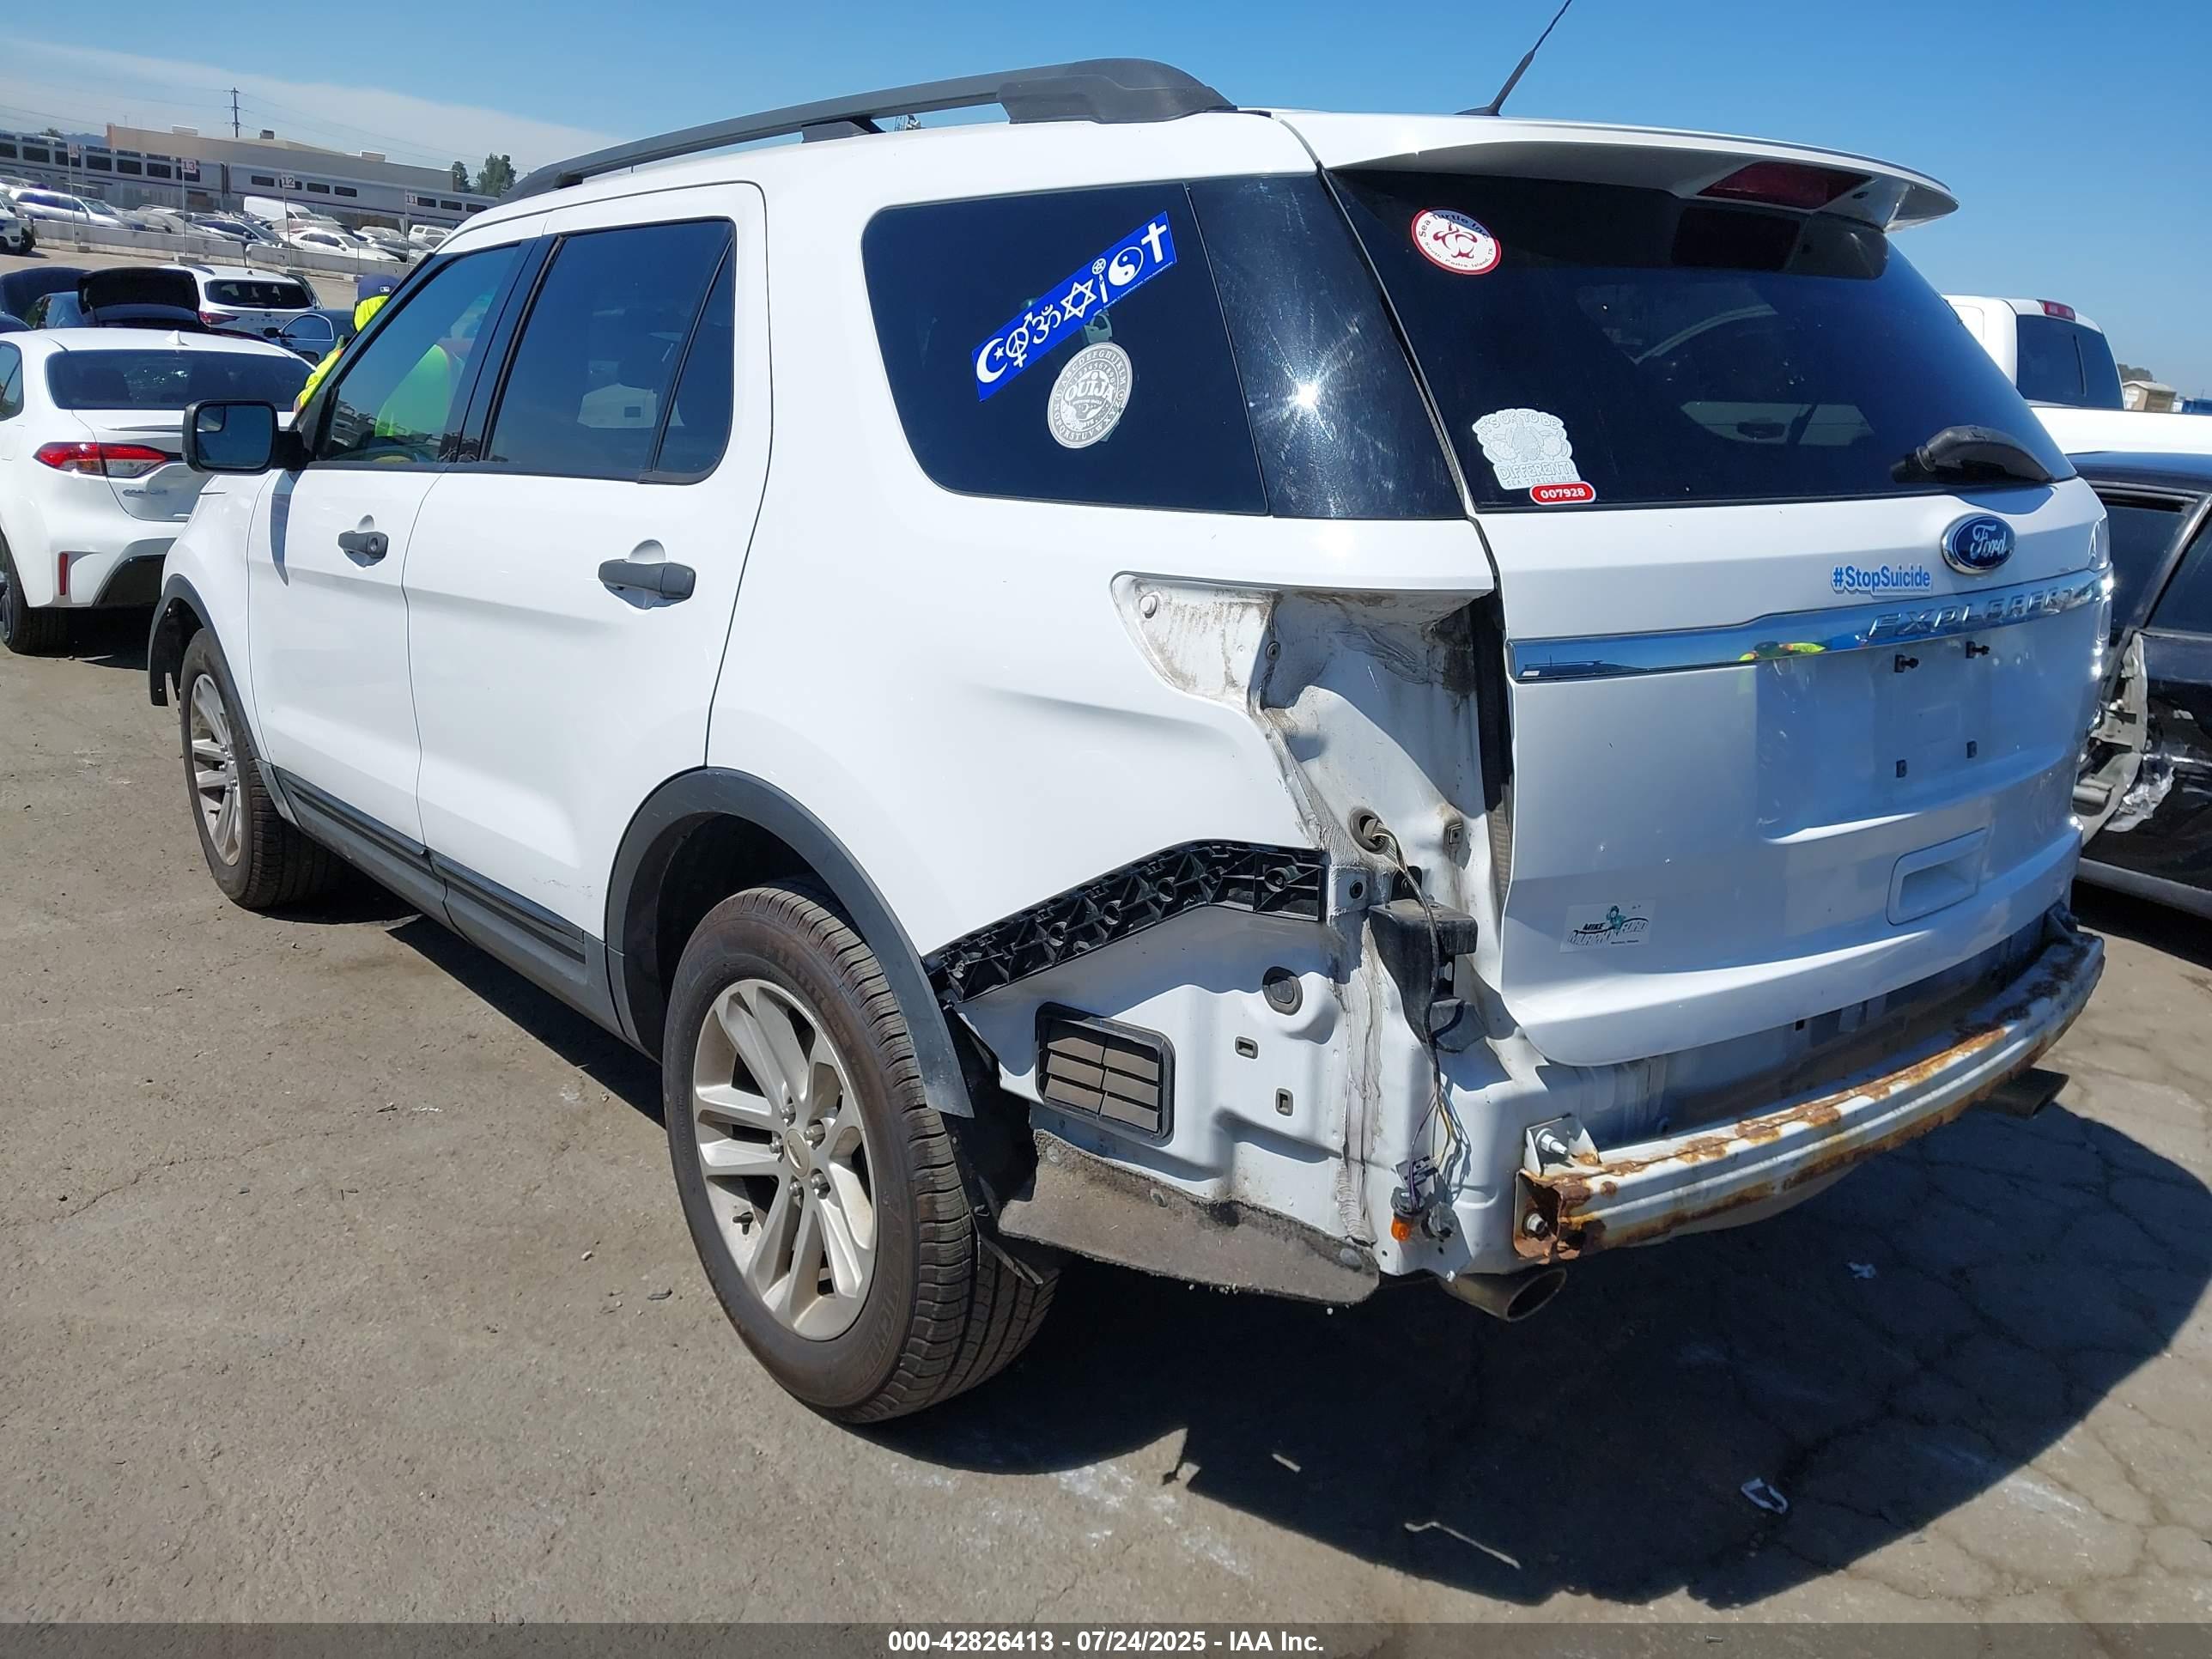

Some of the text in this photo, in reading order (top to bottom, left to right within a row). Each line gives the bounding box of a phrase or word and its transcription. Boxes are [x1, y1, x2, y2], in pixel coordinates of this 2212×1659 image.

[182, 160, 196, 171] 13
[281, 176, 295, 187] 12
[405, 194, 417, 204] 11
[1418, 211, 1490, 242] Sea Turtle Inc.
[1063, 380, 1115, 404] OUIJA
[1476, 410, 1562, 435] IT'S OK TO BE
[1496, 460, 1576, 481] DIFFERENT!
[1540, 487, 1586, 500] 007928
[1970, 525, 2008, 559] Ford
[1832, 565, 1930, 591] #StopSuicide
[1869, 586, 2065, 637] EXPLORER
